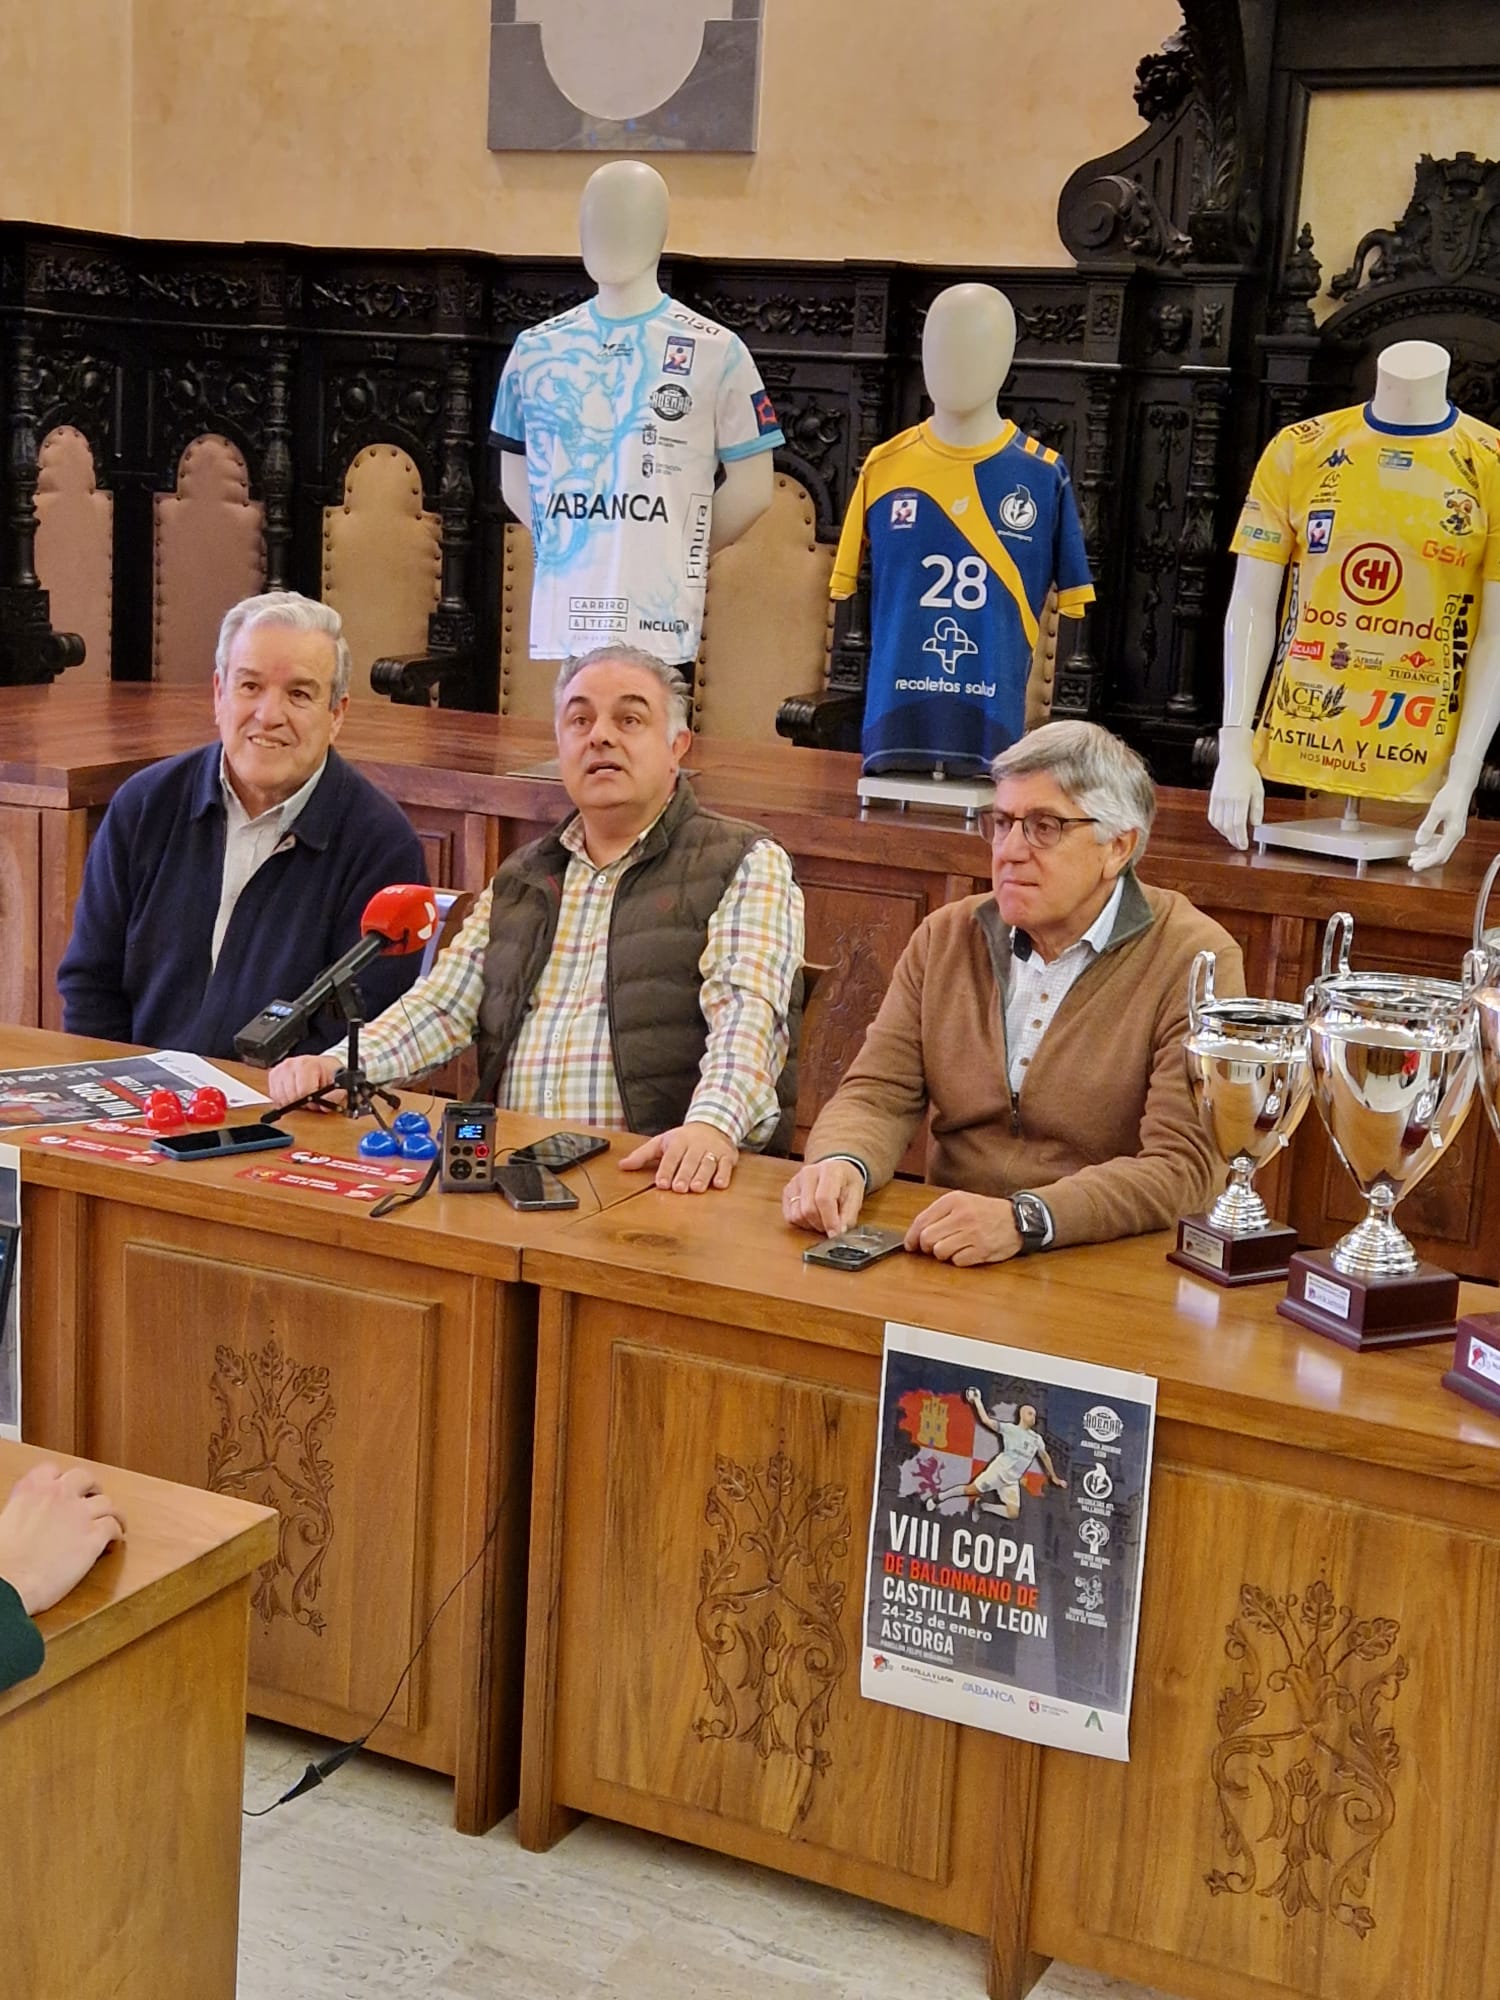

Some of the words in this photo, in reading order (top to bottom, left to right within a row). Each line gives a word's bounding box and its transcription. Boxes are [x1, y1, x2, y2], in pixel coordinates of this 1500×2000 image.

[546, 493, 668, 523] ABANCA
[919, 554, 988, 610] 28
[895, 676, 961, 693] recoletas
[1388, 668, 1440, 684] TUDANCA
[1360, 688, 1436, 730] JJG
[1356, 741, 1369, 759] Y
[1376, 743, 1427, 765] LEÓN
[889, 1510, 940, 1561] VIII
[952, 1528, 1036, 1584] COPA
[884, 1552, 905, 1575] DE
[909, 1557, 1011, 1603] BALONMANO
[1016, 1584, 1039, 1608] DE
[881, 1602, 923, 1624] 24-25
[927, 1614, 946, 1630] de
[949, 1623, 993, 1642] enero
[882, 1576, 971, 1620] CASTILLA
[978, 1600, 991, 1624] Y
[997, 1605, 1048, 1639] LEON
[881, 1618, 954, 1656] ASTORGA
